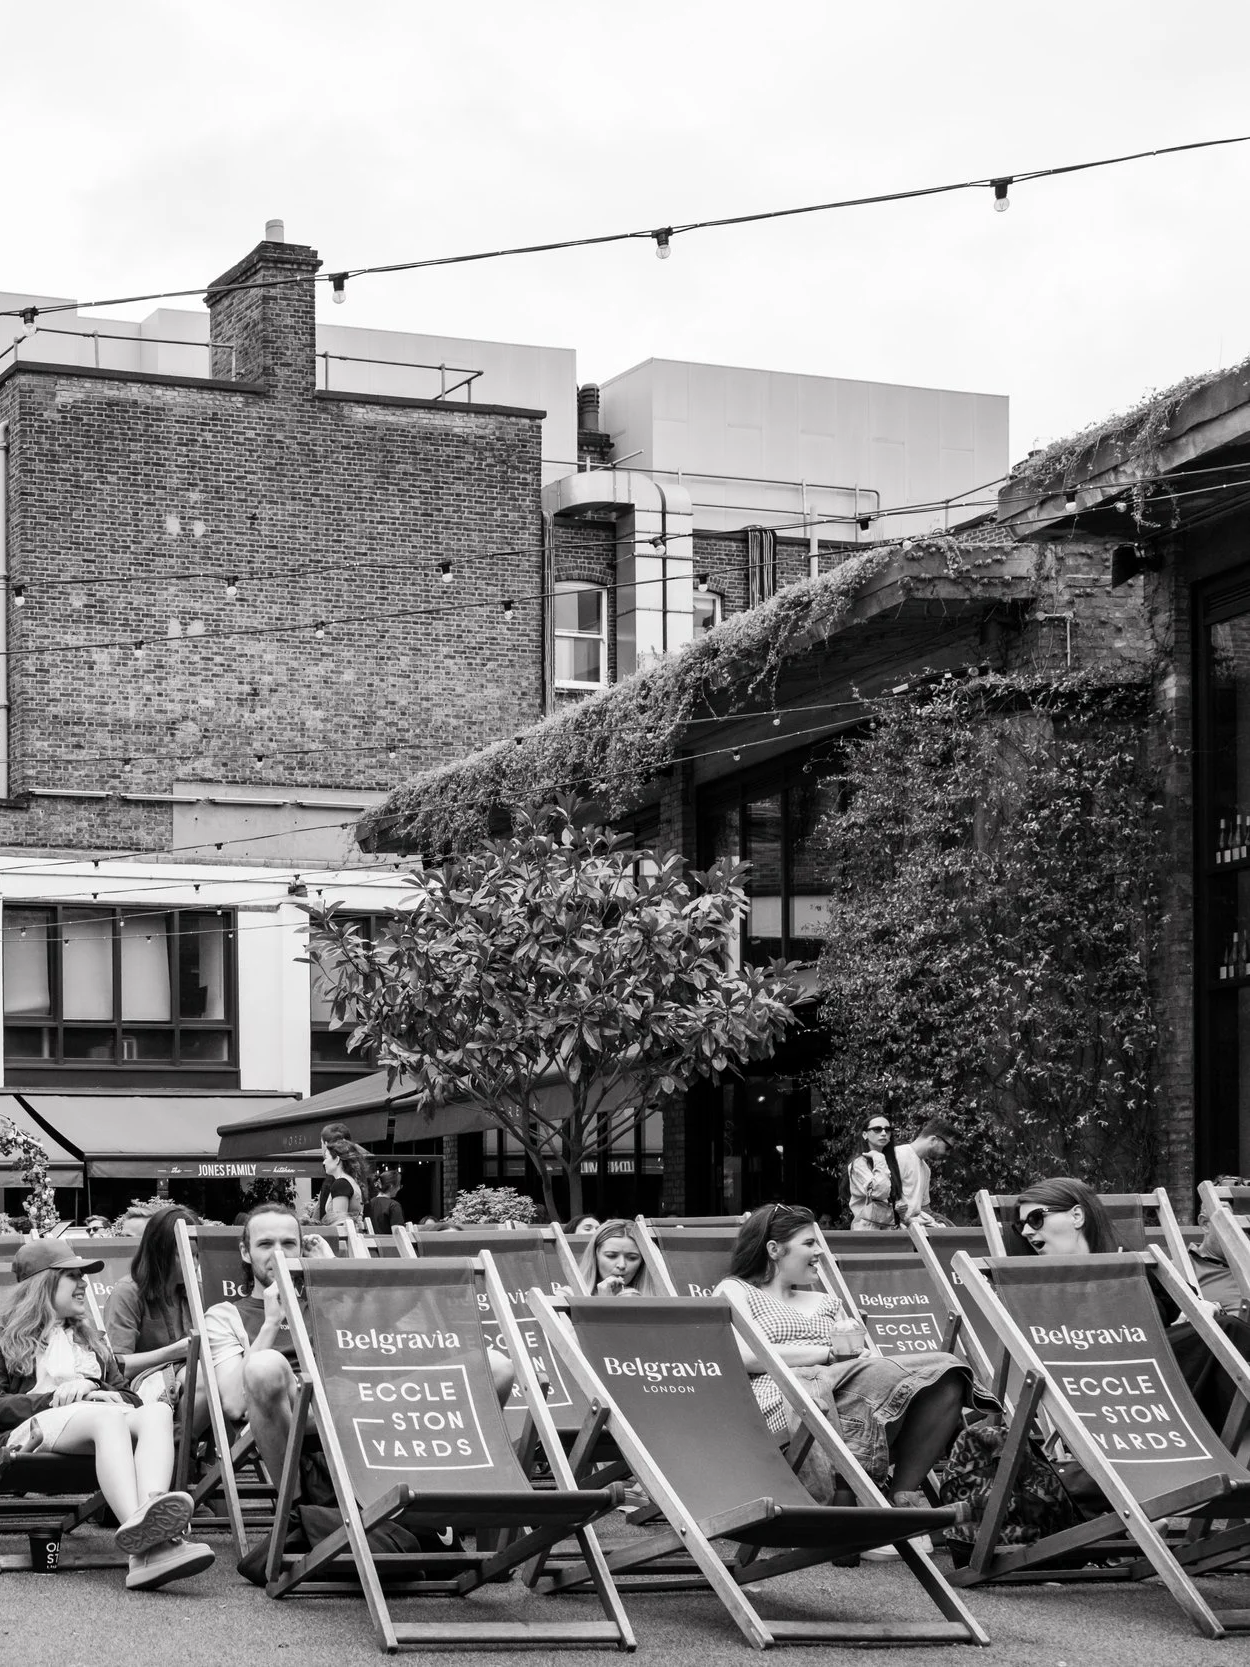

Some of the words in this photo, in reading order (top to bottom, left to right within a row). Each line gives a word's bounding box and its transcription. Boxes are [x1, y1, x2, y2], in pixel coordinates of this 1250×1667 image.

[171, 1166, 182, 1174] the
[198, 1163, 225, 1177] JONES
[226, 1163, 257, 1176] FAMILY
[272, 1166, 296, 1174] kitchen
[859, 1293, 930, 1309] Belgravia
[875, 1322, 931, 1336] ECCLE
[1029, 1324, 1147, 1350] Belgravia
[336, 1328, 461, 1355] Belgravia
[896, 1339, 938, 1352] STON
[603, 1357, 723, 1382] Belgravia
[358, 1381, 457, 1402] ECCLE
[643, 1385, 695, 1393] LONDON
[1062, 1375, 1156, 1396] ECCLE
[391, 1410, 464, 1431] STON
[1101, 1403, 1171, 1424] STON
[372, 1438, 474, 1457] YARDS
[1092, 1430, 1187, 1450] YARDS
